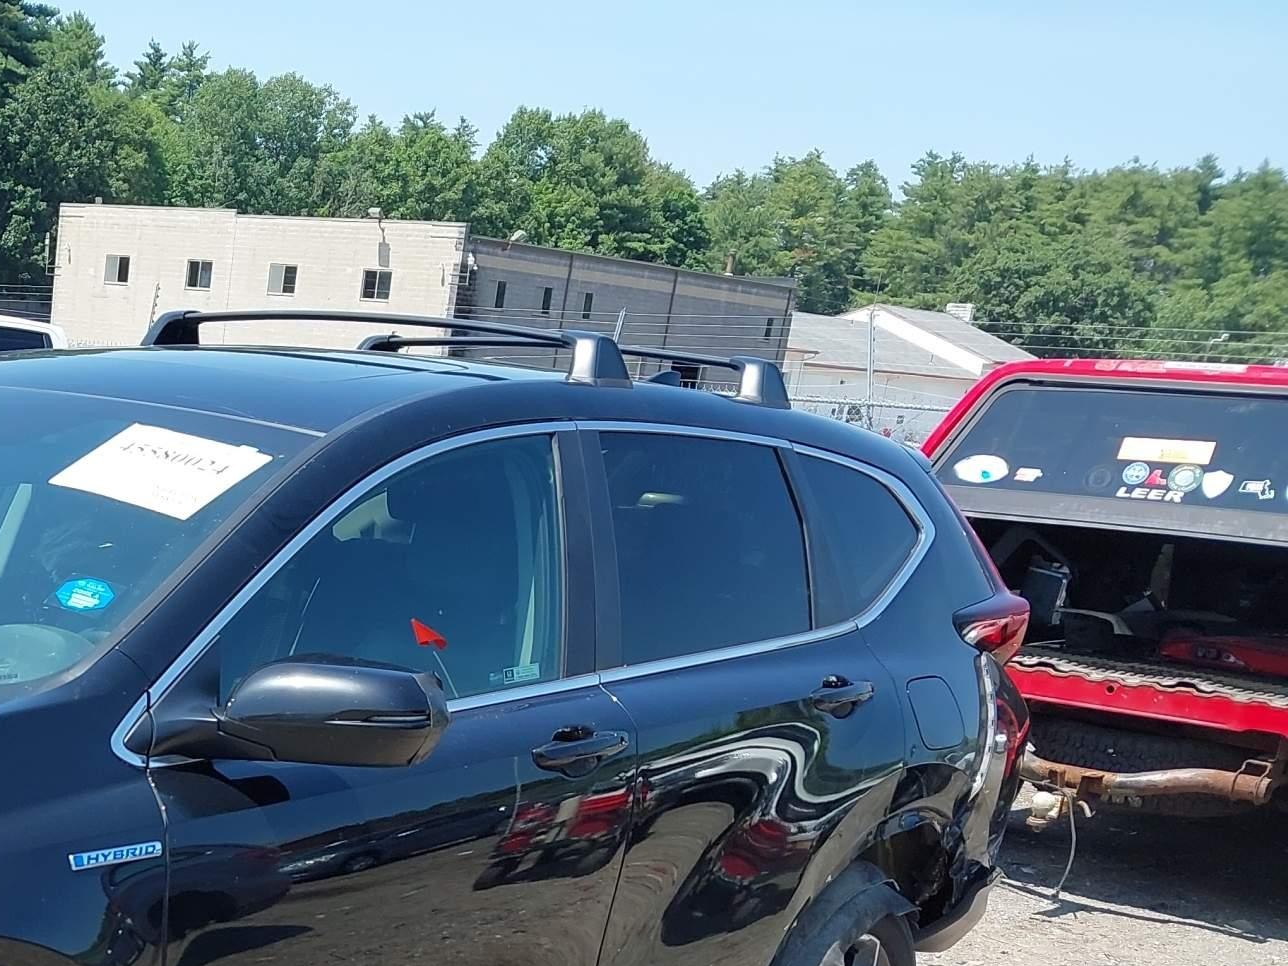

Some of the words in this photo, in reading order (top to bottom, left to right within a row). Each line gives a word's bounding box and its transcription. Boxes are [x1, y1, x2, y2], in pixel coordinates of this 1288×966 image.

[119, 440, 232, 476] 45580024
[1114, 485, 1186, 503] LEER
[86, 843, 157, 865] HYBRID
